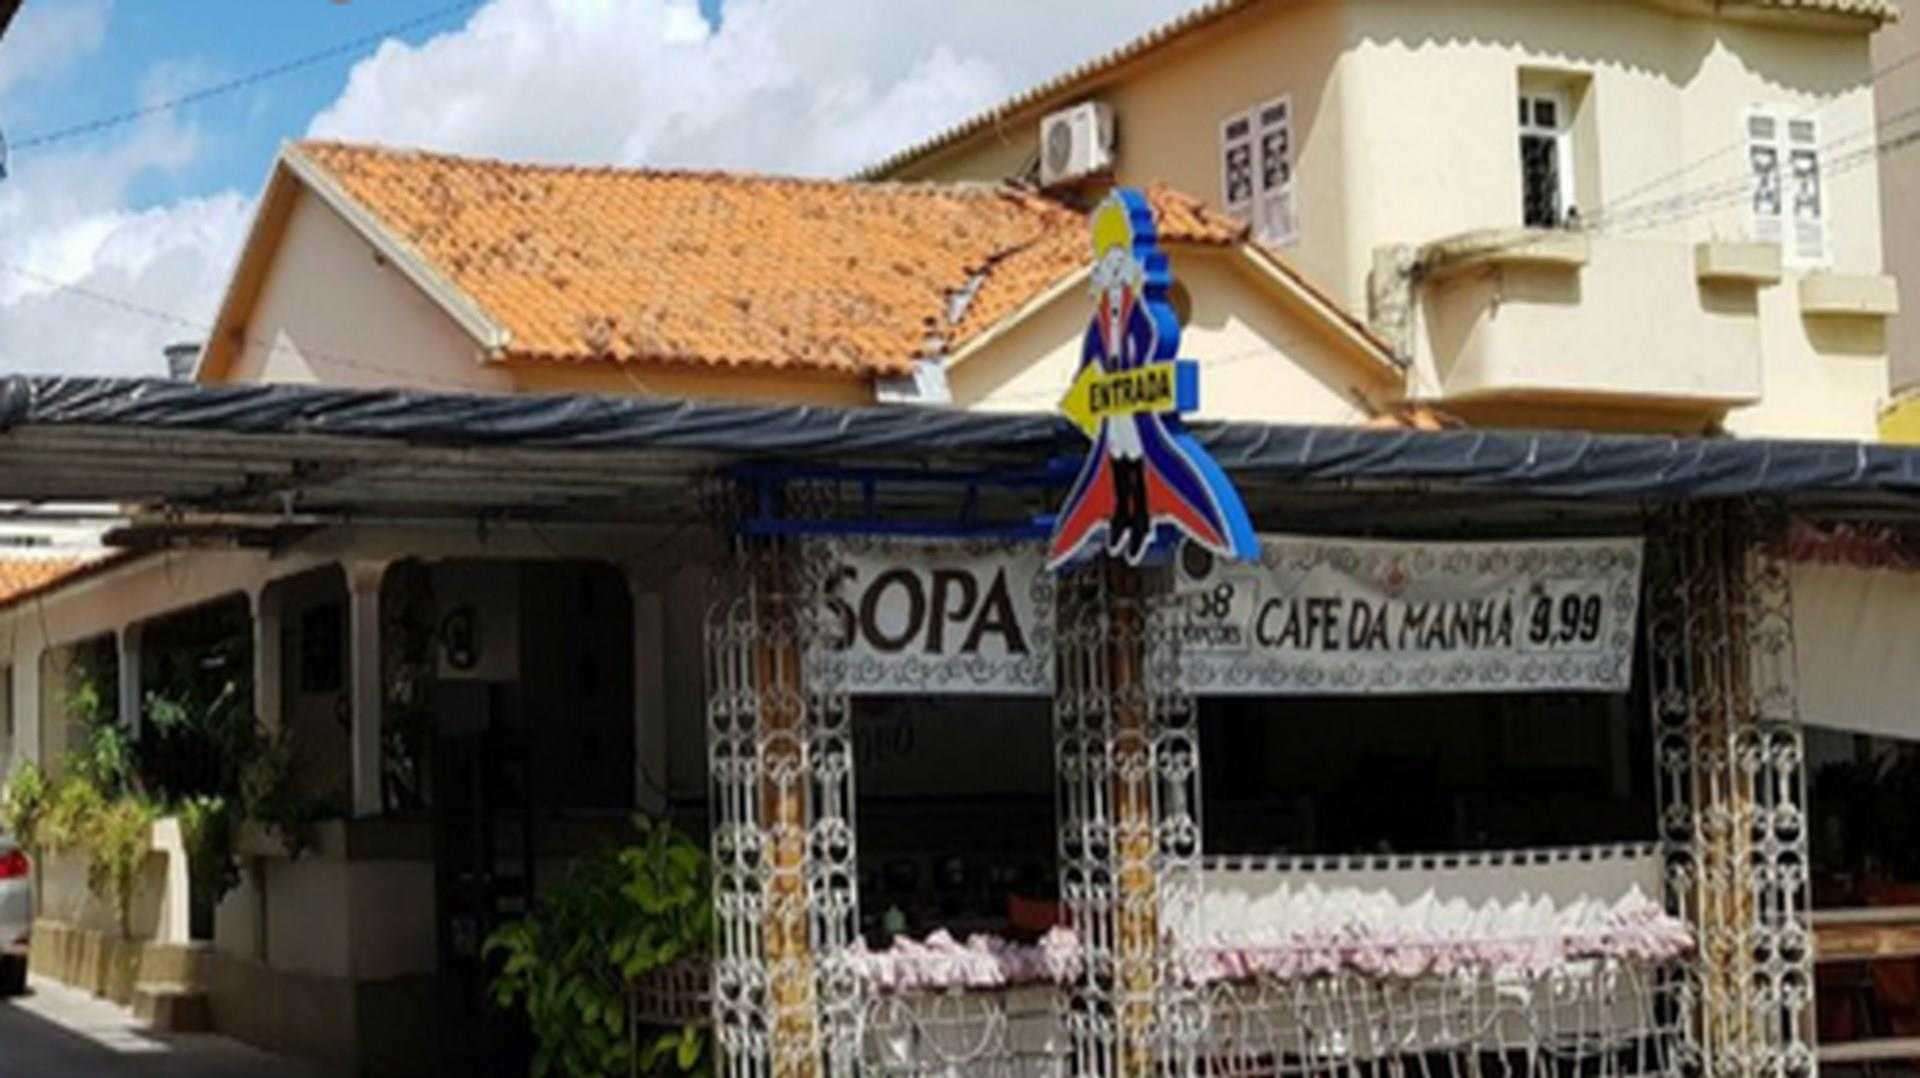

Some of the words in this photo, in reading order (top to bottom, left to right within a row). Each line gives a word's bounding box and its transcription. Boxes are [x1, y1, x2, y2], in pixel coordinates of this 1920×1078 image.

[1089, 369, 1171, 413] ENTRADA
[822, 565, 1030, 656] SOPA
[1348, 597, 1389, 650] DA
[1528, 593, 1602, 648] 9,99
